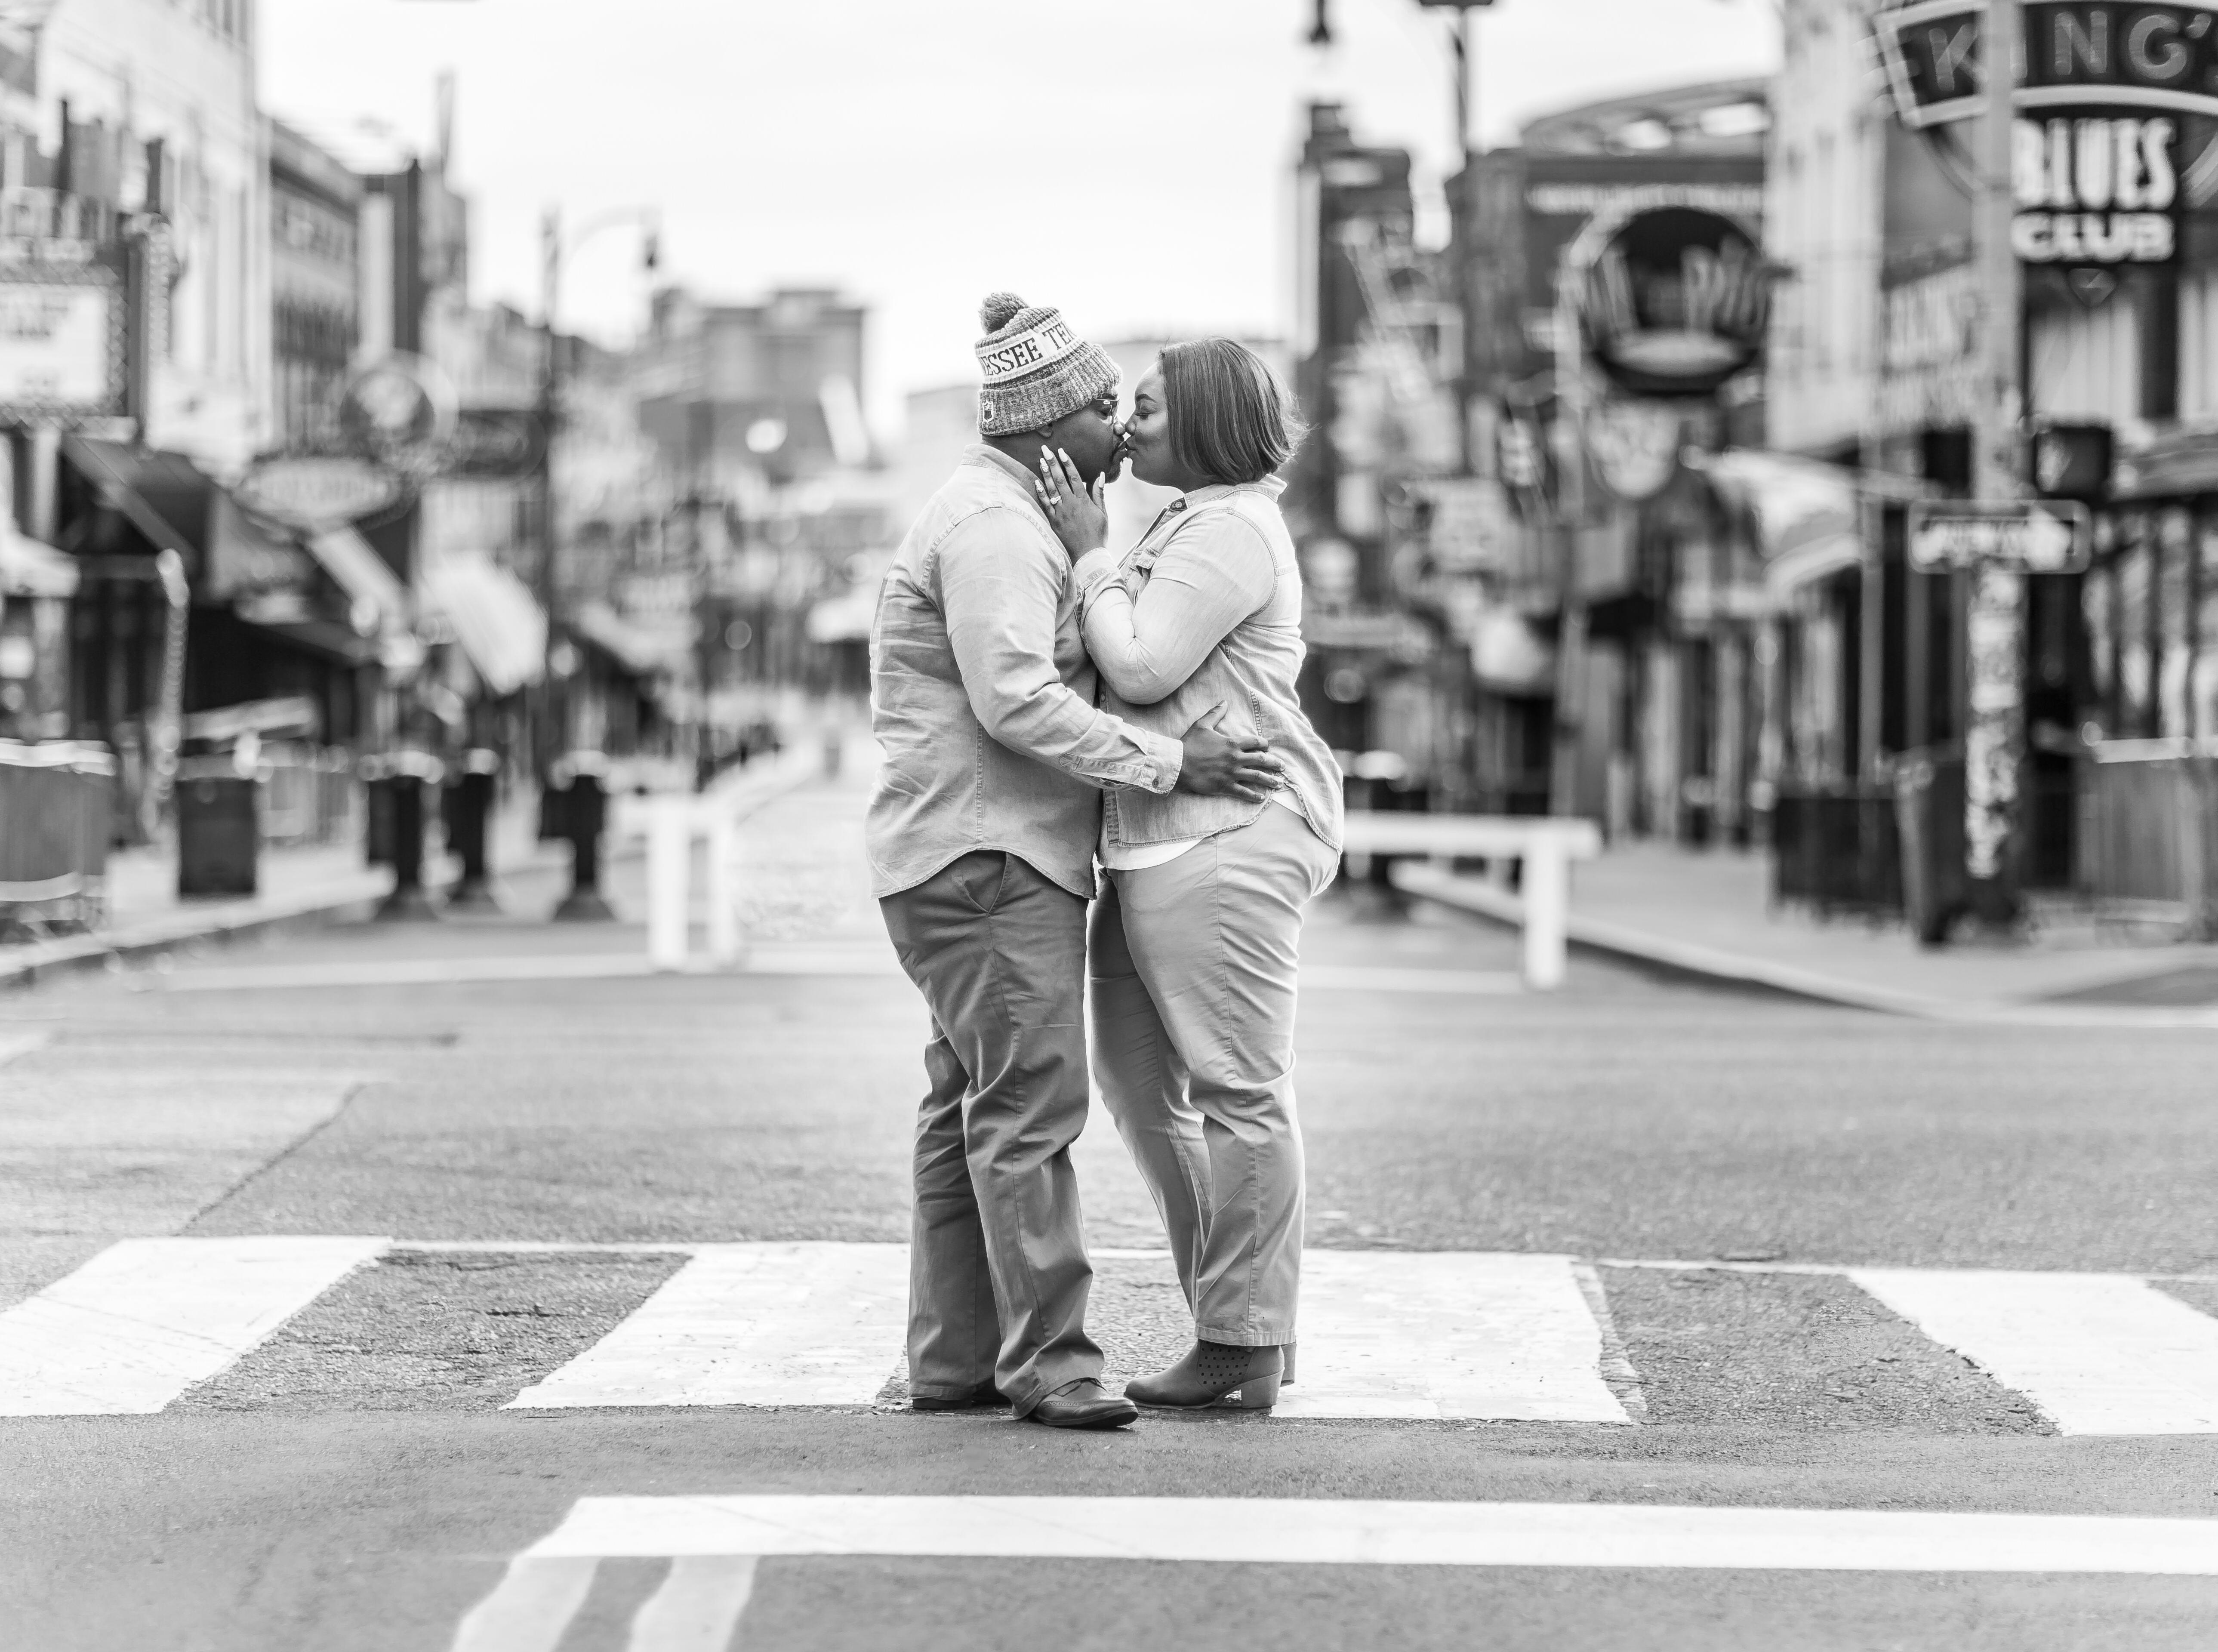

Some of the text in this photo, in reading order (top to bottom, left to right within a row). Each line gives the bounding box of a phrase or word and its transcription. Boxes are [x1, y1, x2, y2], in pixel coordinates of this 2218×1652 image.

[1928, 9, 2218, 92] KING'
[2011, 212, 2175, 263] CLUB
[979, 337, 1043, 376] ESSEE
